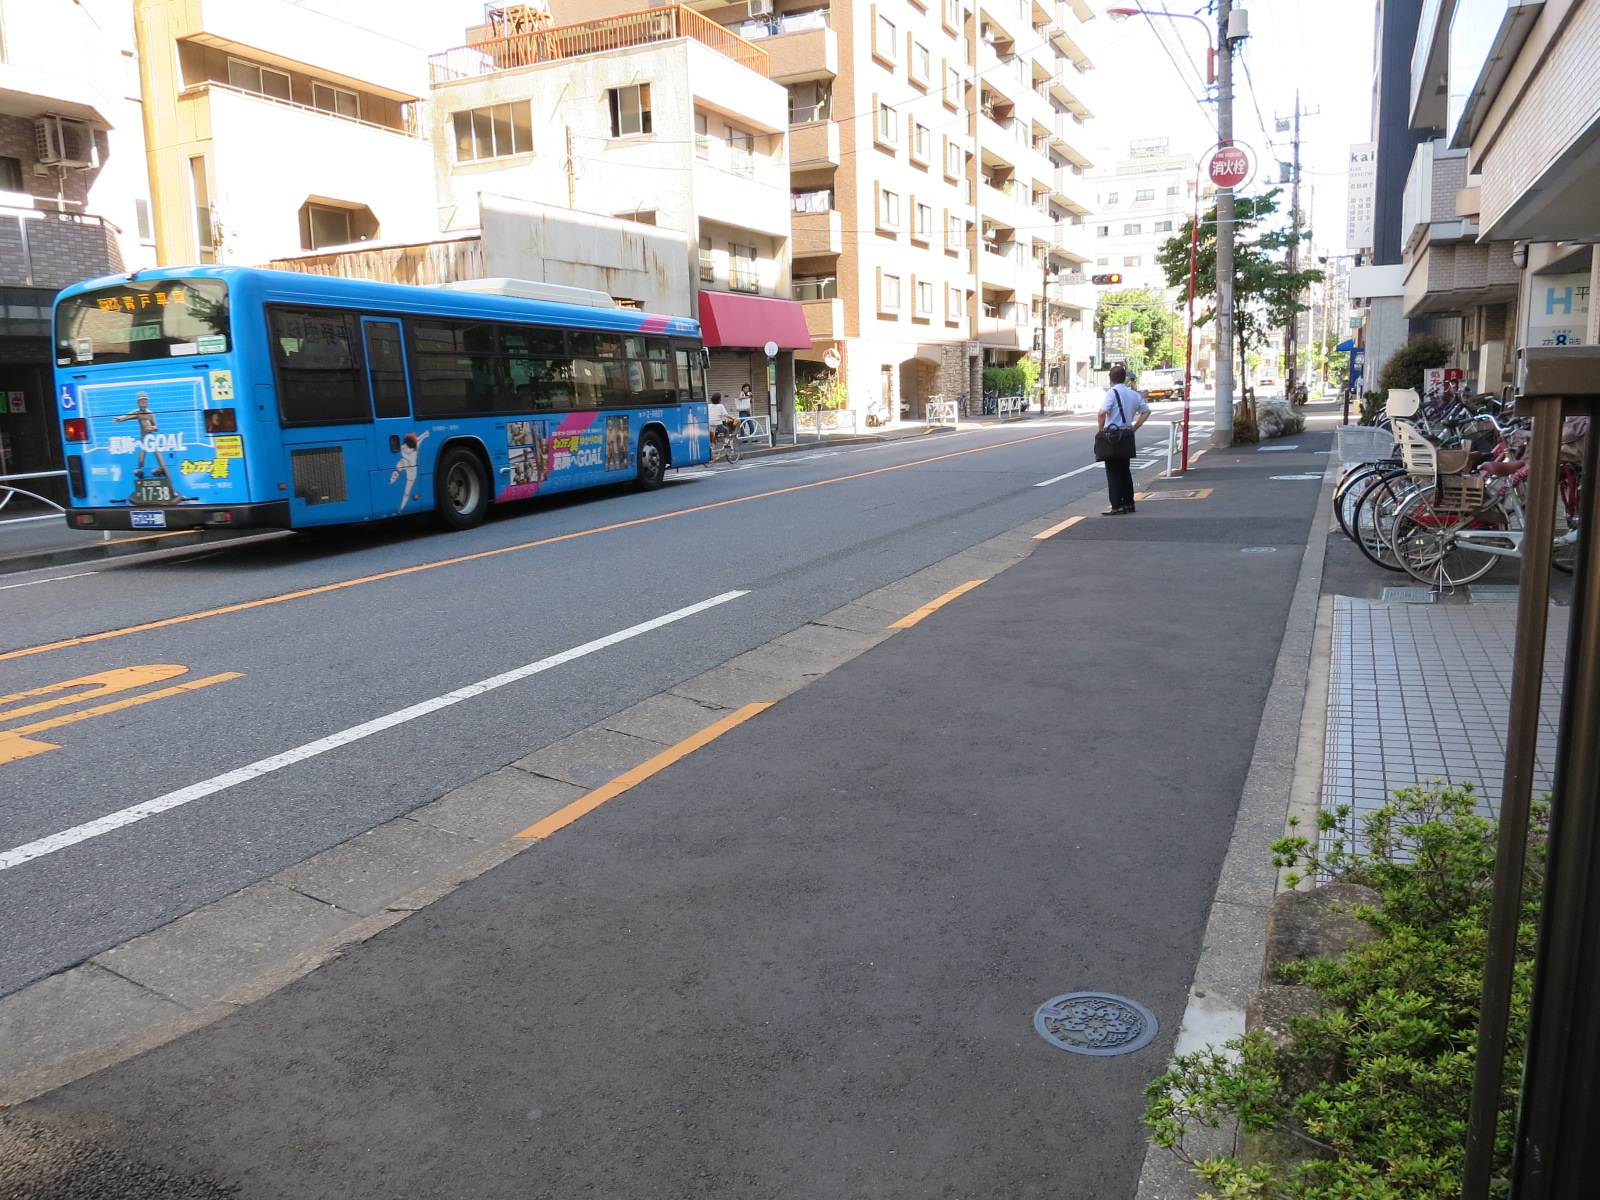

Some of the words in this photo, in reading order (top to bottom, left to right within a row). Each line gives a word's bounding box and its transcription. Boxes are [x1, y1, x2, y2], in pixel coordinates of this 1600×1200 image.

[1351, 151, 1374, 162] kai
[1212, 159, 1246, 176] 消火栓
[141, 487, 171, 501] 17-38
